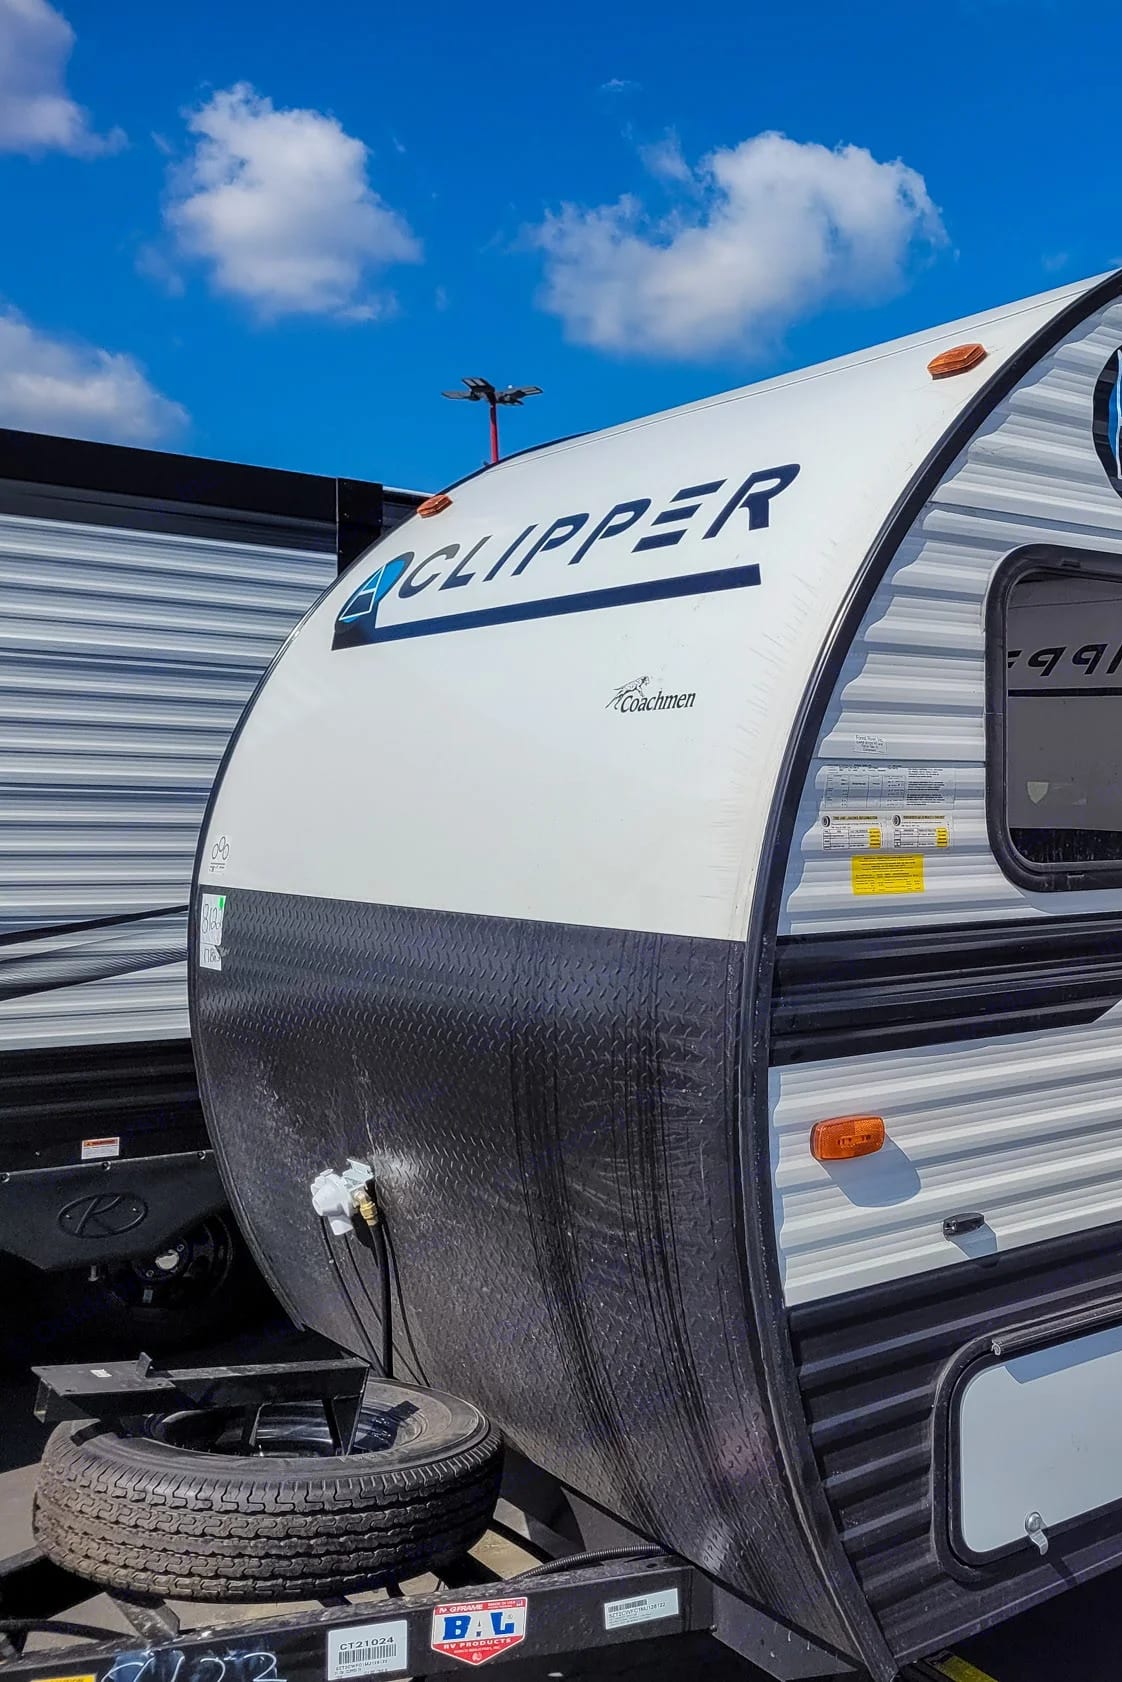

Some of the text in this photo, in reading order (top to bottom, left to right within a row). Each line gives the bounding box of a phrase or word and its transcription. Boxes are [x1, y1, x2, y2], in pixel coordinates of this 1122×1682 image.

[398, 463, 801, 599] CLIPPER
[620, 690, 696, 713] Coachmen
[442, 1612, 515, 1641] BAL
[340, 1636, 394, 1651] CT21024
[460, 1637, 511, 1648] PRODUCTS
